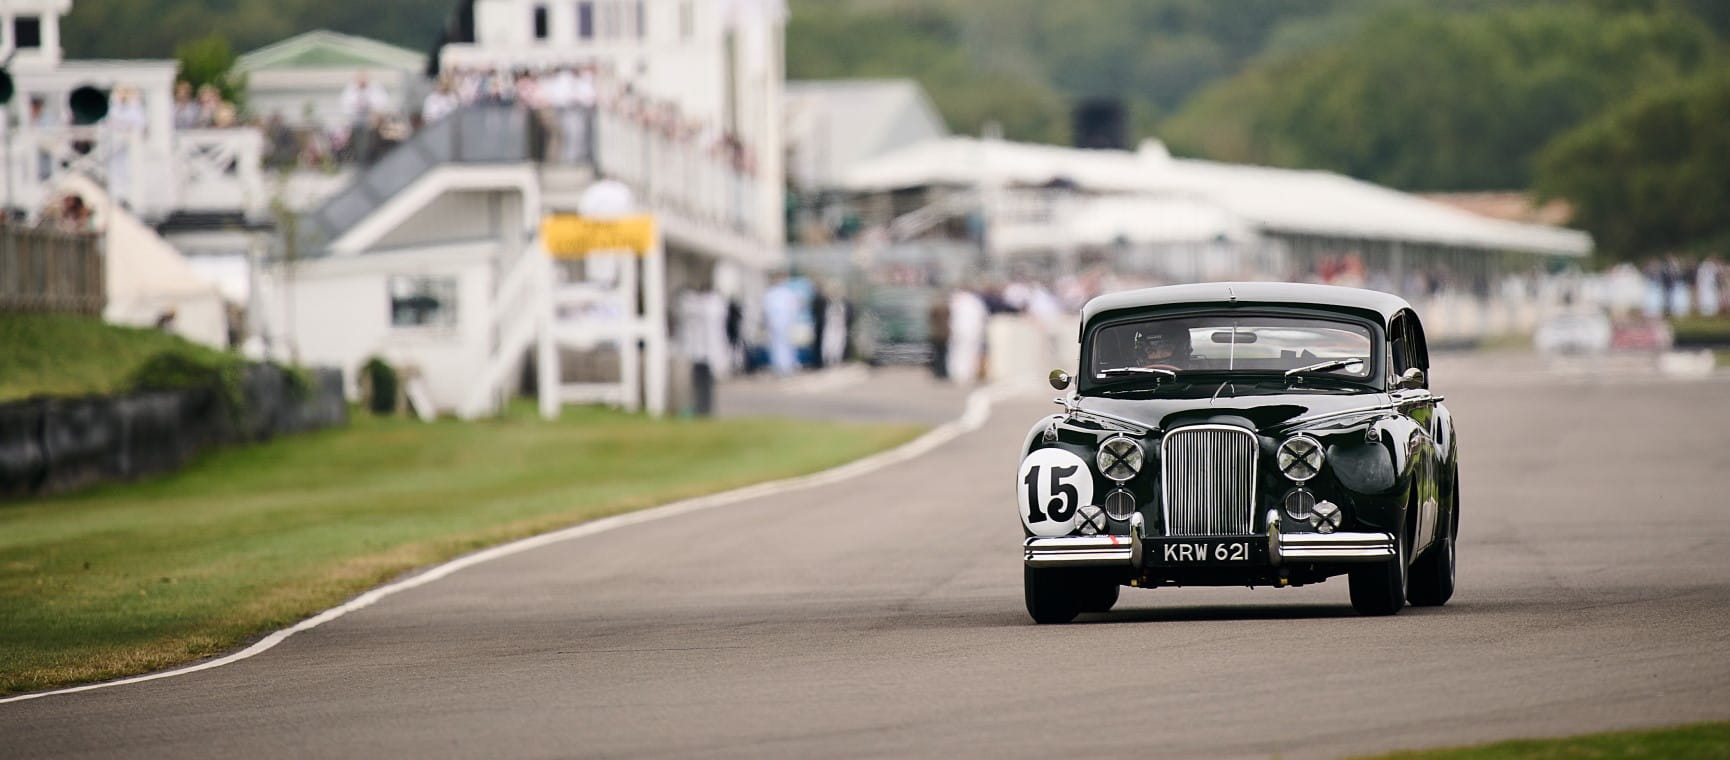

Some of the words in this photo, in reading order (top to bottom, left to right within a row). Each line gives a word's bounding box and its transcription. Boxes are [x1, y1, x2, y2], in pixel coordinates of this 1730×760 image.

[1024, 465, 1079, 524] 15
[1163, 544, 1208, 562] KRW
[1214, 543, 1249, 561] 621
